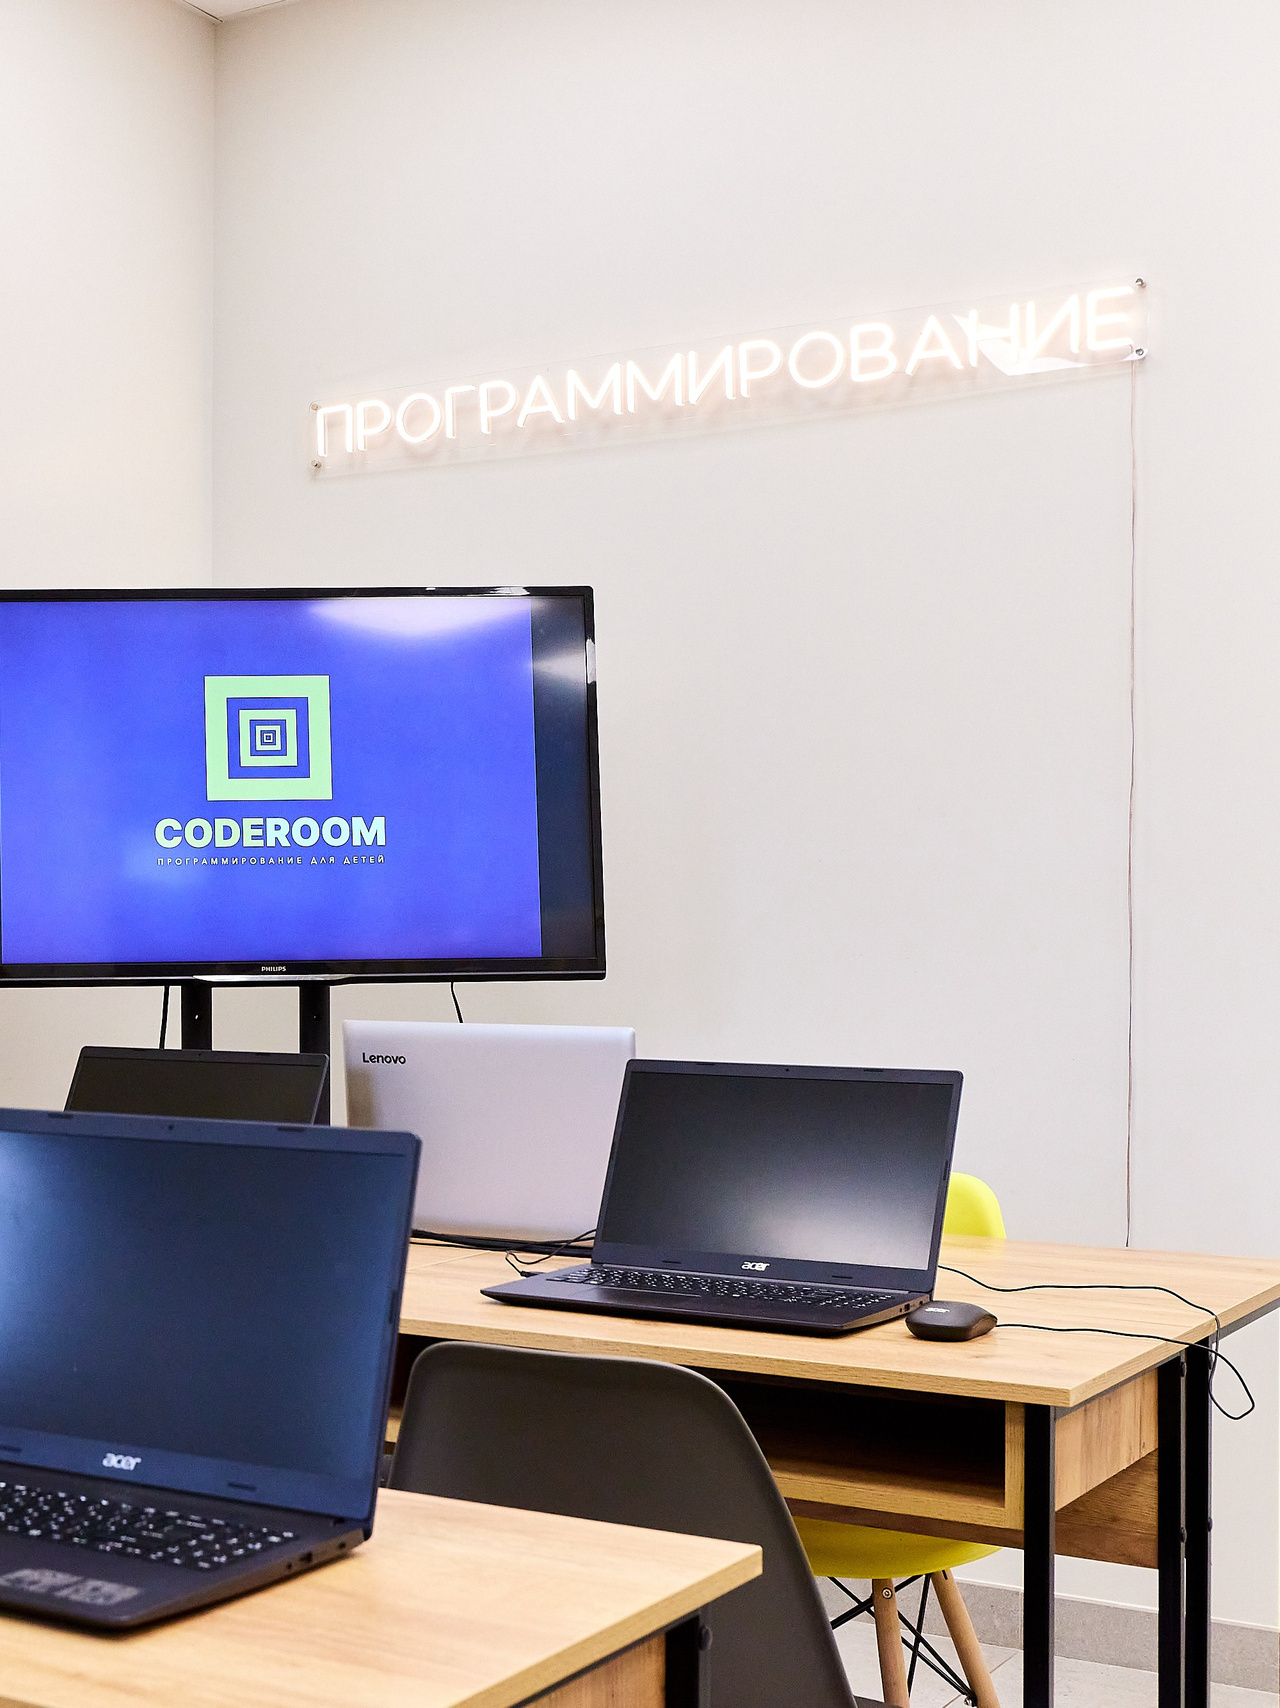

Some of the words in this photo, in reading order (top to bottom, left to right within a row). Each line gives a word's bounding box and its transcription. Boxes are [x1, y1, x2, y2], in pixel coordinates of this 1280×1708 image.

[314, 284, 1136, 456] ПРОГРАММИРОВАНИЕ
[154, 815, 387, 849] CODEROOM
[156, 855, 303, 866] ПРОГРАММИРОВАНИЕ
[310, 855, 336, 866] ДЛЯ
[342, 854, 386, 865] ДЕТЕЙ
[362, 1052, 407, 1065] Lenovo
[741, 1261, 771, 1272] acer
[102, 1452, 142, 1471] acer
